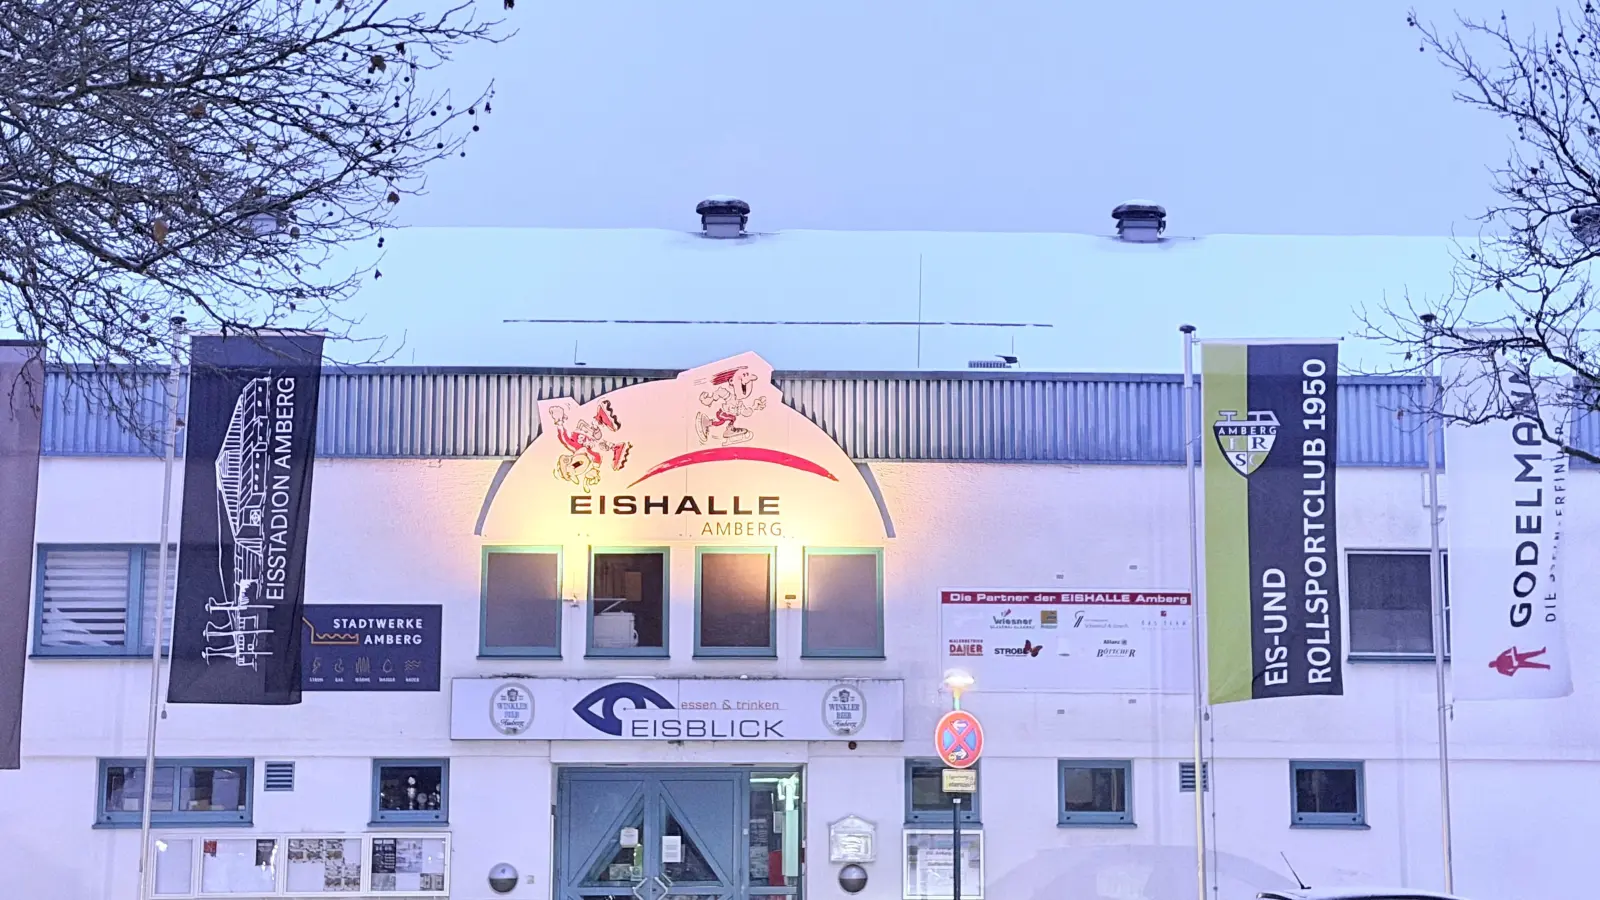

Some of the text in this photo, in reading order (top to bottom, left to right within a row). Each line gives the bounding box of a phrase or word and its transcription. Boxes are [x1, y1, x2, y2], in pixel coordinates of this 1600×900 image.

[1218, 426, 1277, 435] AMBERG
[266, 377, 295, 600] EISSTADION AMBERG
[570, 495, 780, 515] EISHALLE
[701, 522, 782, 536] AMBERG
[1302, 358, 1332, 684] ROLLSPORTCLUB 1950
[950, 593, 1188, 605] Die Partner der EISHALLE Amberg
[1544, 592, 1557, 623] DIE
[333, 618, 423, 629] STADTWERKE
[1262, 568, 1288, 686] EIS-UND
[364, 634, 422, 645] AMBERG
[681, 700, 779, 710] essen & trinken
[631, 719, 784, 738] EISBLICK
